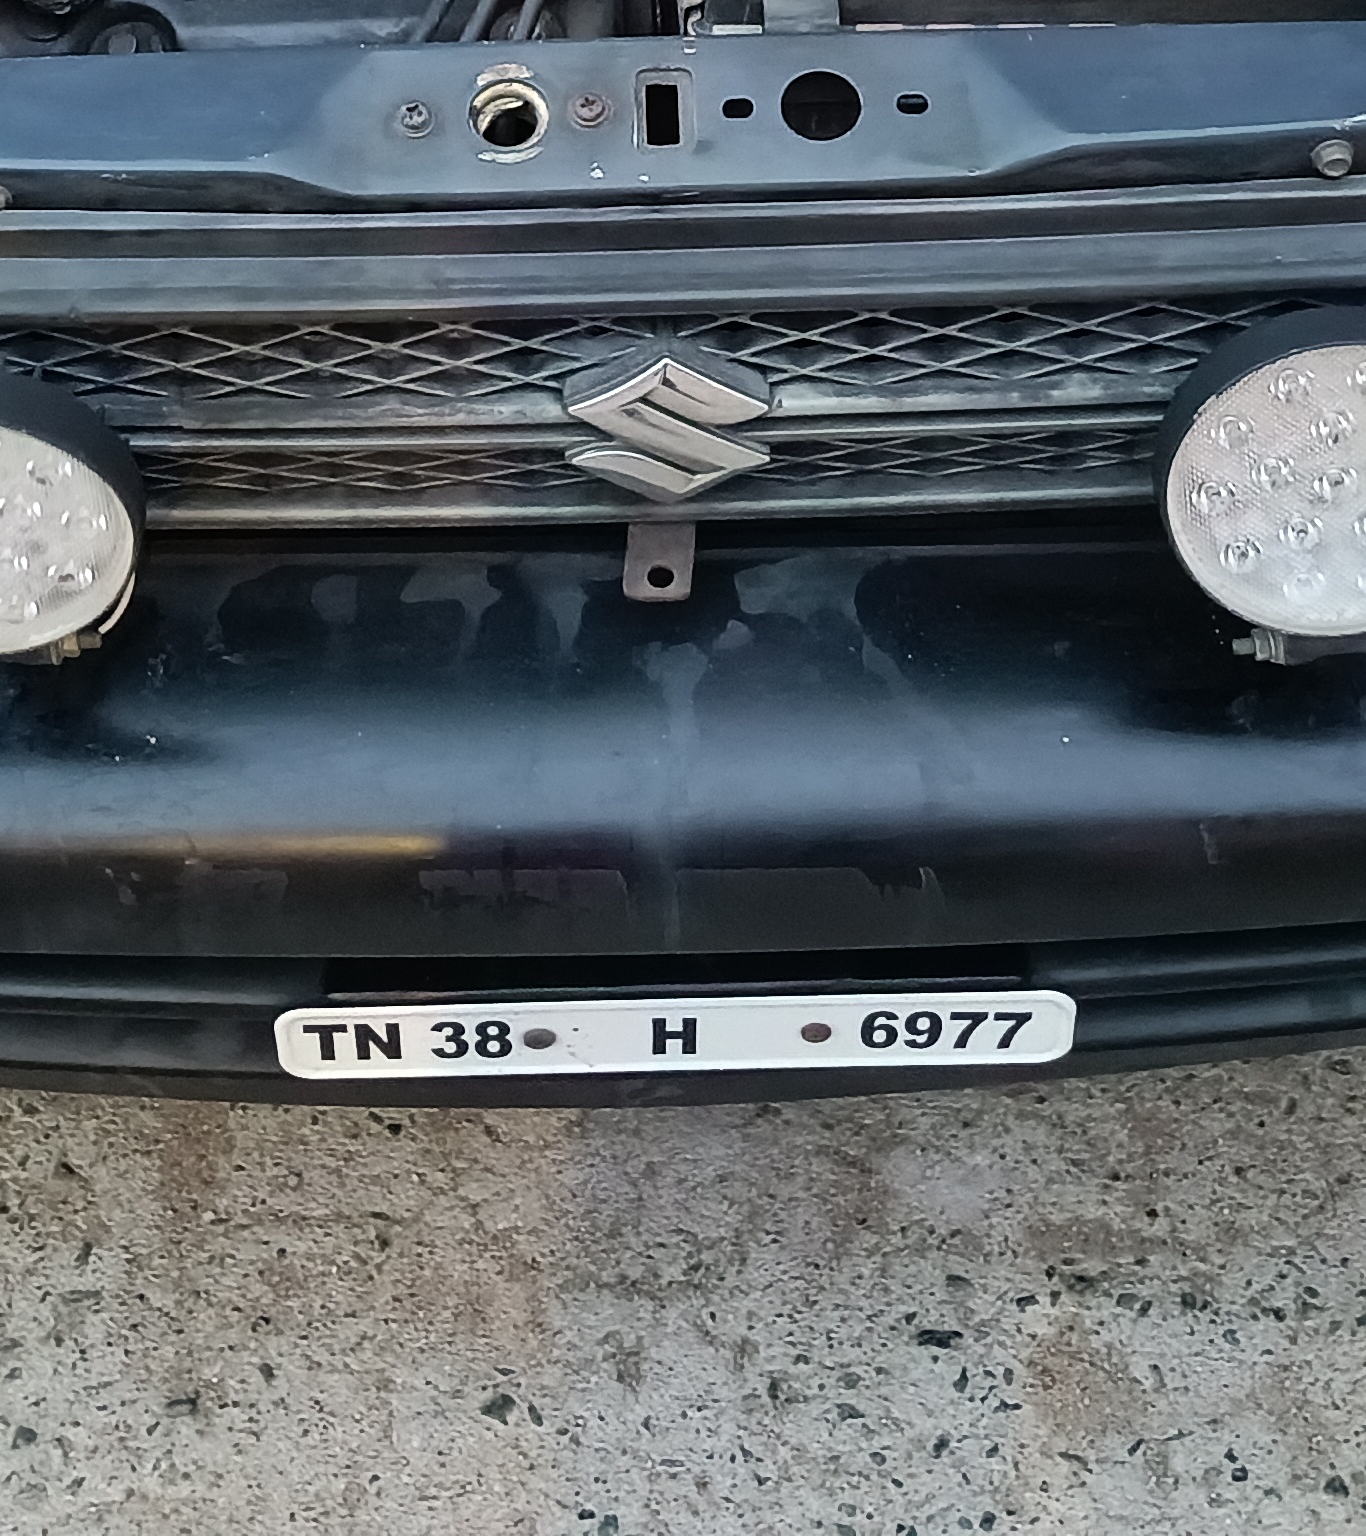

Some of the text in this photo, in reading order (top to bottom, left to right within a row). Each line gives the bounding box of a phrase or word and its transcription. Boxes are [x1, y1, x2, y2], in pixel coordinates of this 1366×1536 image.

[302, 1010, 1034, 1061] TN 38 H 6977
